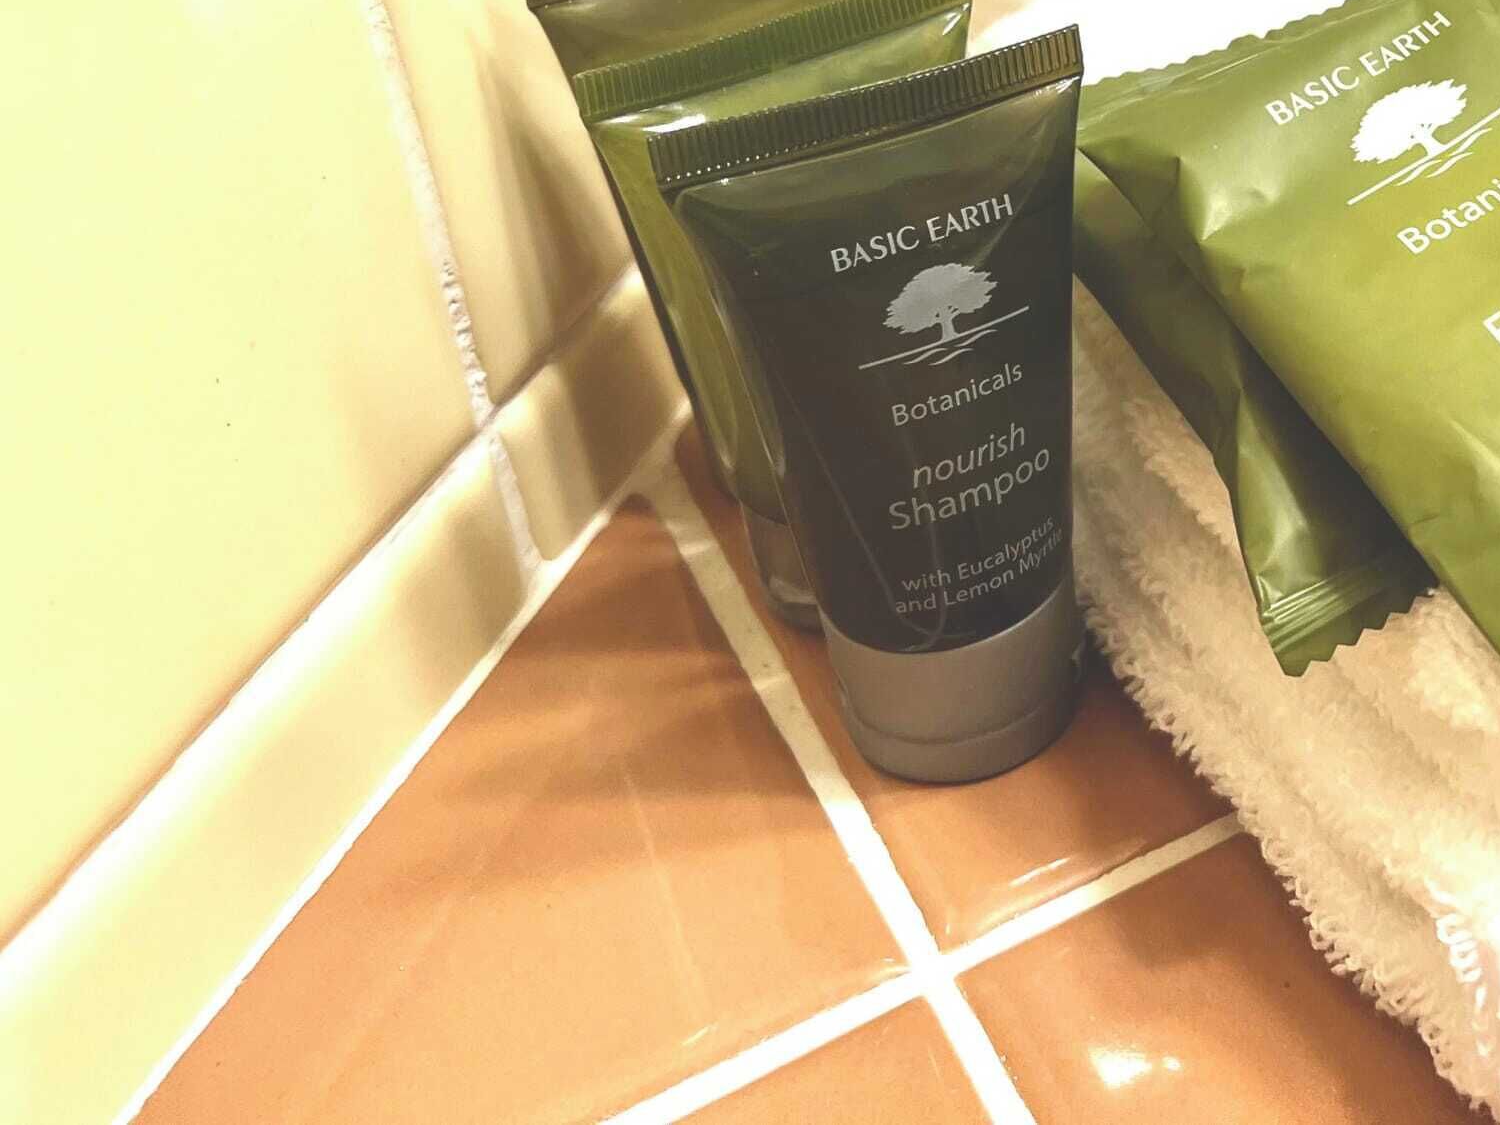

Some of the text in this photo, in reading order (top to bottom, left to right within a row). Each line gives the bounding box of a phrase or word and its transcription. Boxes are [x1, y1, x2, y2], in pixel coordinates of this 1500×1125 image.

[1264, 10, 1452, 126] BASIC EARTH
[830, 193, 1014, 273] BASIC EARTH
[891, 362, 1024, 427] Botanicals
[888, 448, 1050, 530] Shampoo
[913, 422, 1026, 489] nourish
[895, 528, 1064, 613] and Lemon Myrtle
[902, 516, 1055, 592] with Eucalyptus
